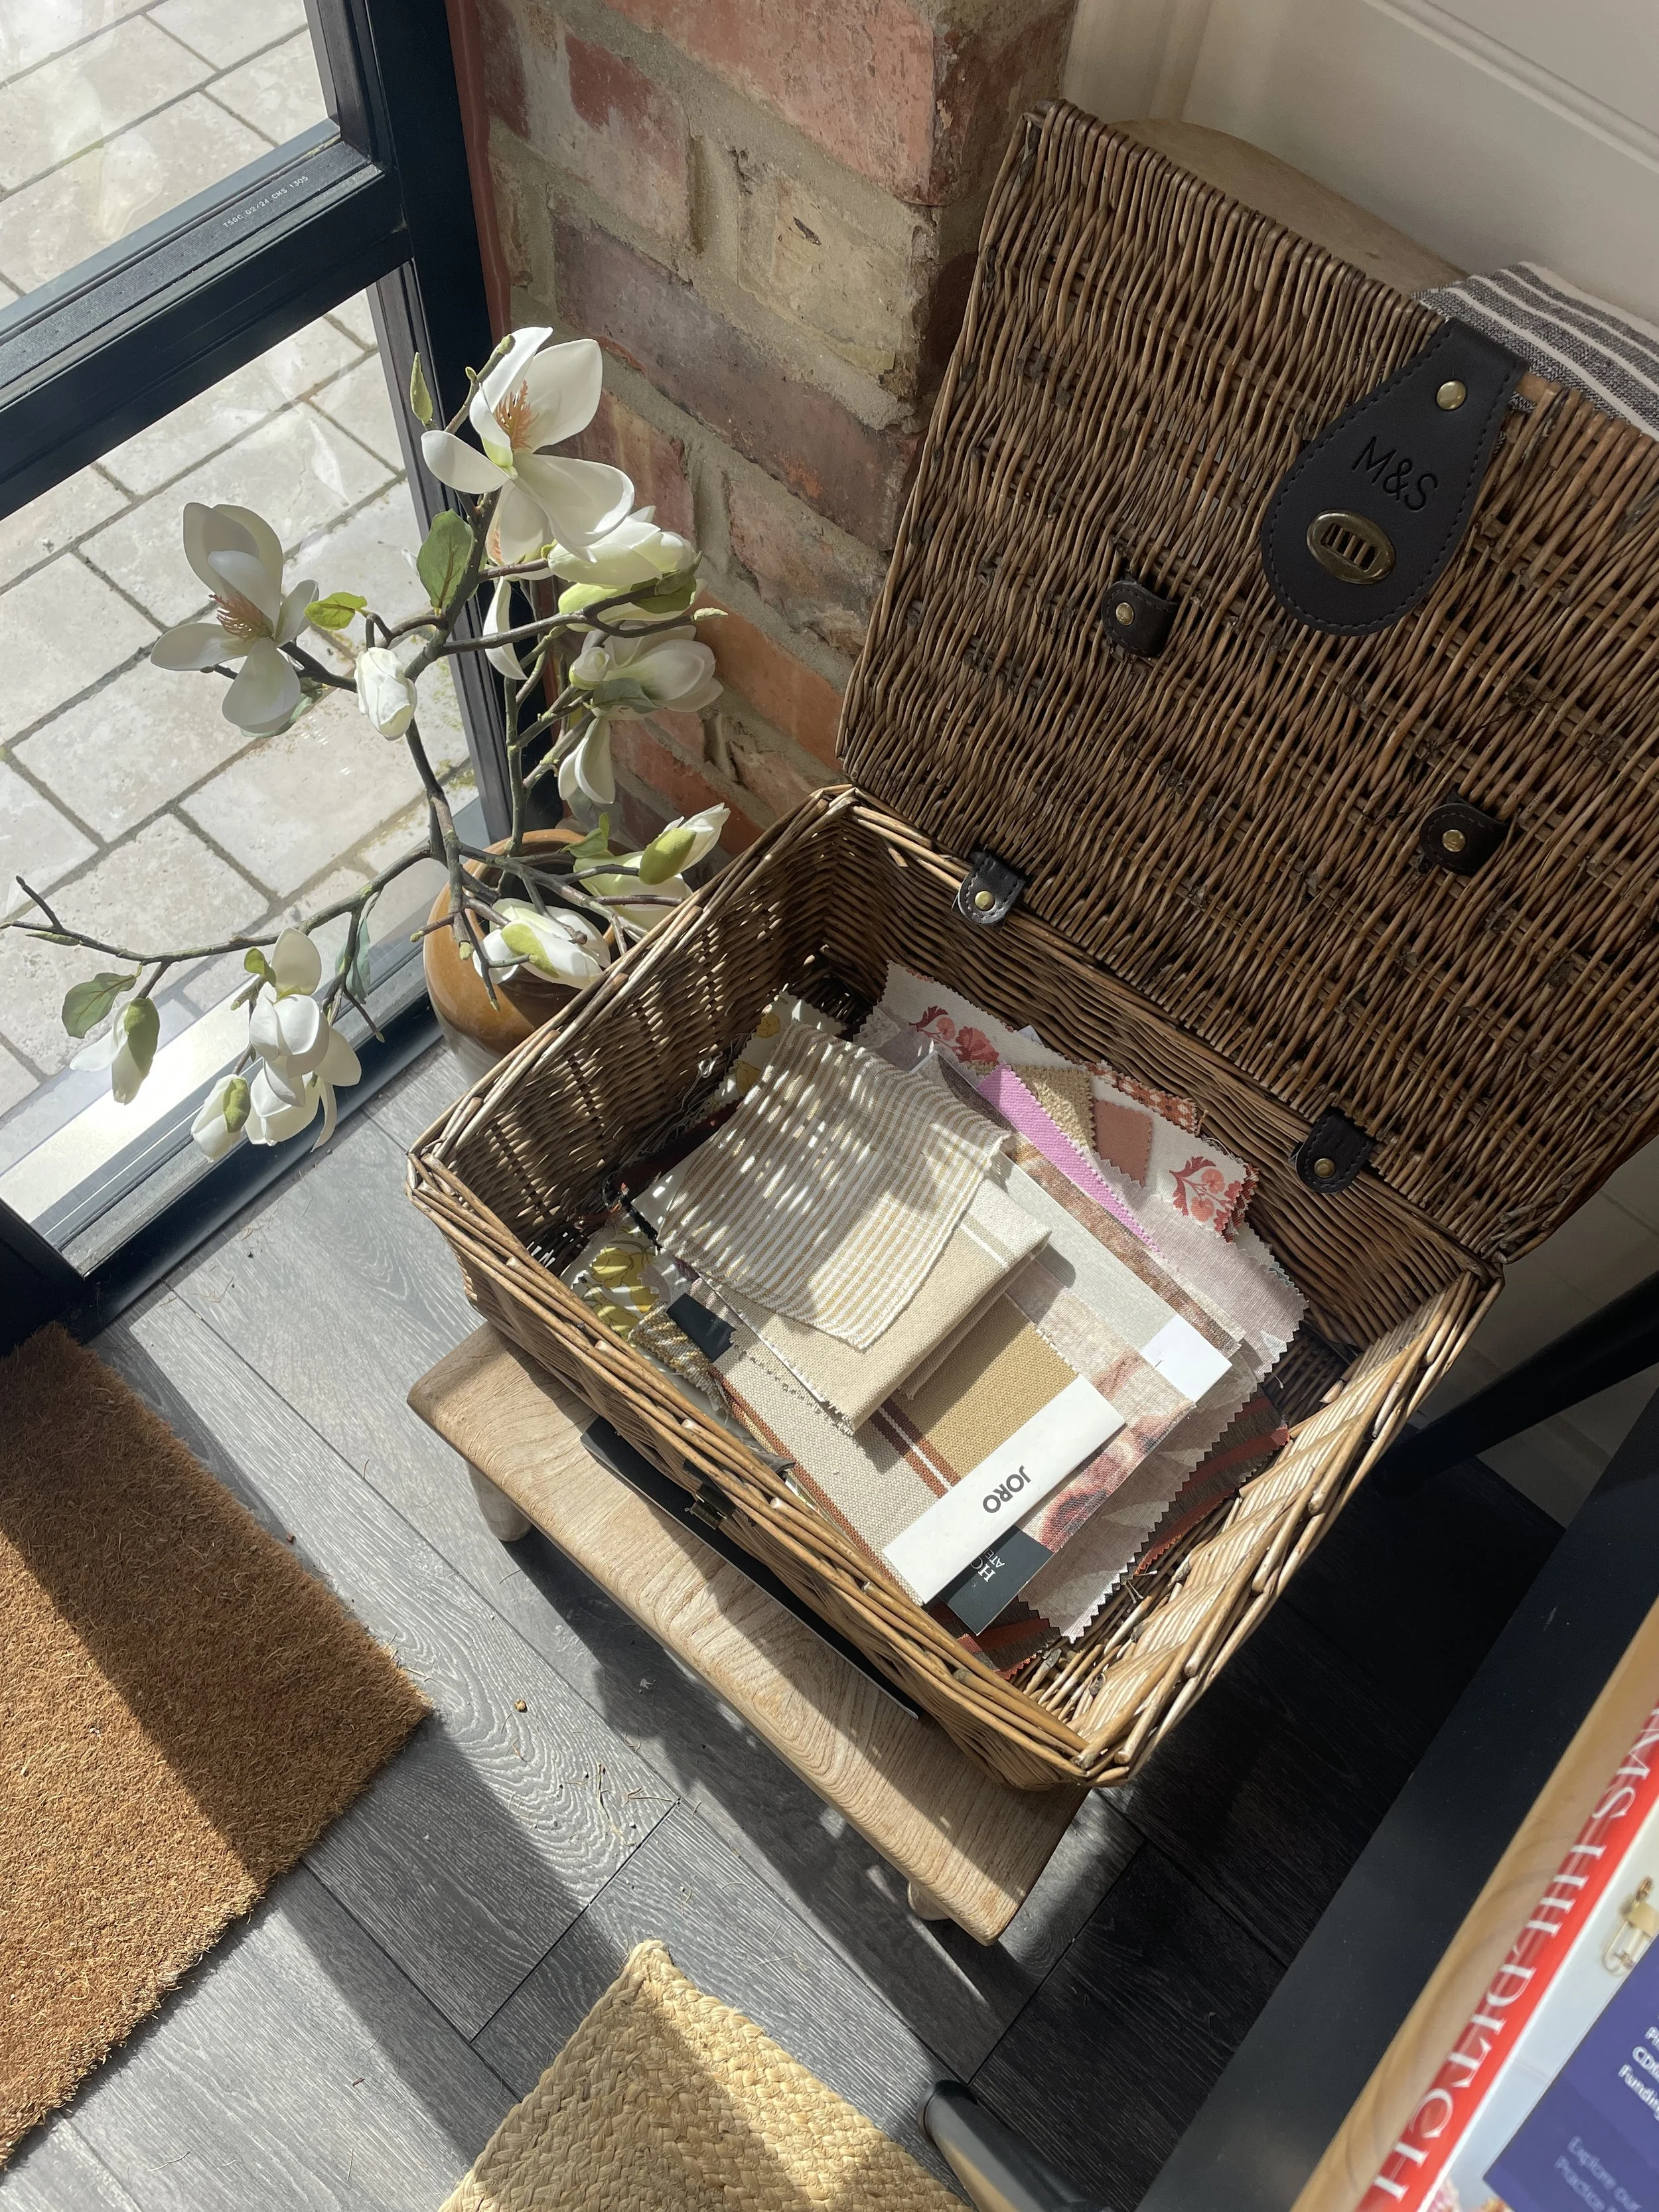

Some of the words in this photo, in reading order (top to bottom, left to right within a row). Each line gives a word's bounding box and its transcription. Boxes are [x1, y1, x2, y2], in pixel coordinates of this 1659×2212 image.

[1352, 435, 1439, 512] M&S
[983, 1465, 1031, 1513] JORO
[970, 1556, 996, 1582] HO
[1373, 1843, 1608, 2204] HILDITCH
